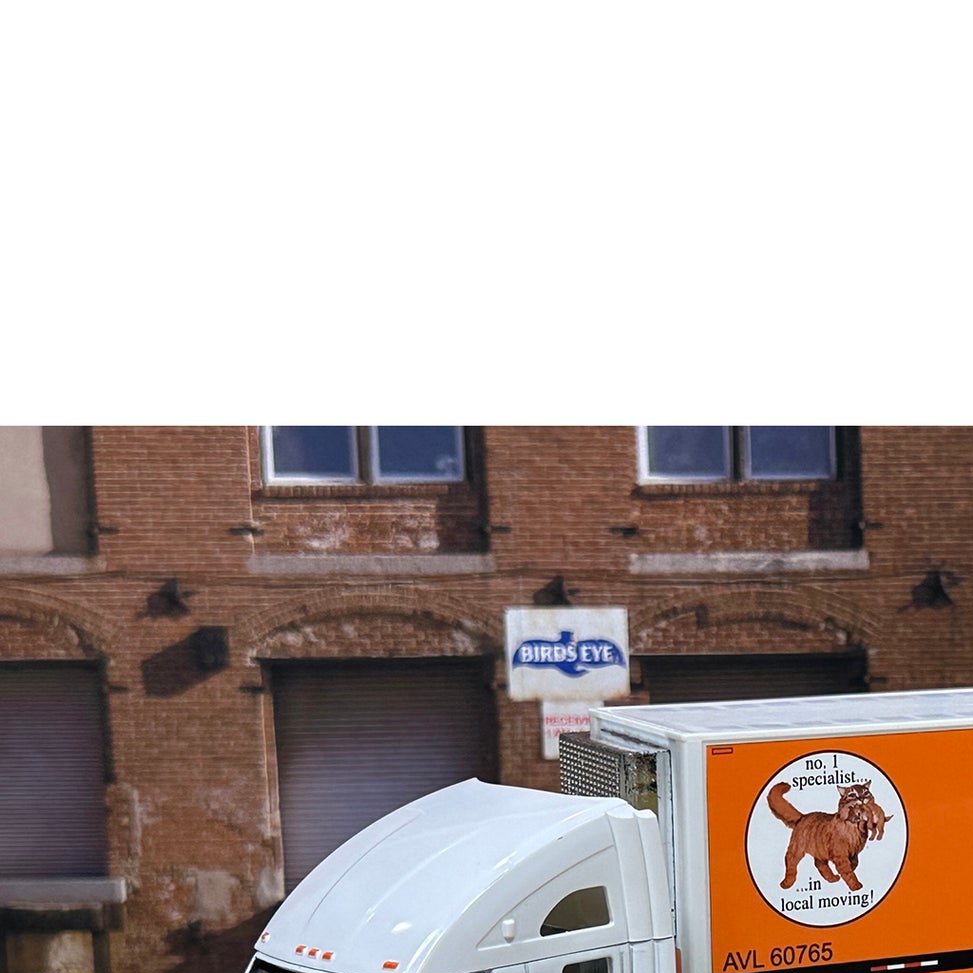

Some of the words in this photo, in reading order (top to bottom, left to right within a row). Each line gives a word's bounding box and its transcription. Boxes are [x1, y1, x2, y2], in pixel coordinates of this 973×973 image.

[521, 641, 577, 663] BIRDS
[581, 644, 613, 663] EYE
[805, 757, 827, 770] no.
[833, 754, 838, 769] 1
[781, 894, 814, 912] local
[818, 890, 875, 909] moving!
[723, 950, 765, 972] AVL
[770, 942, 833, 966] 60765
